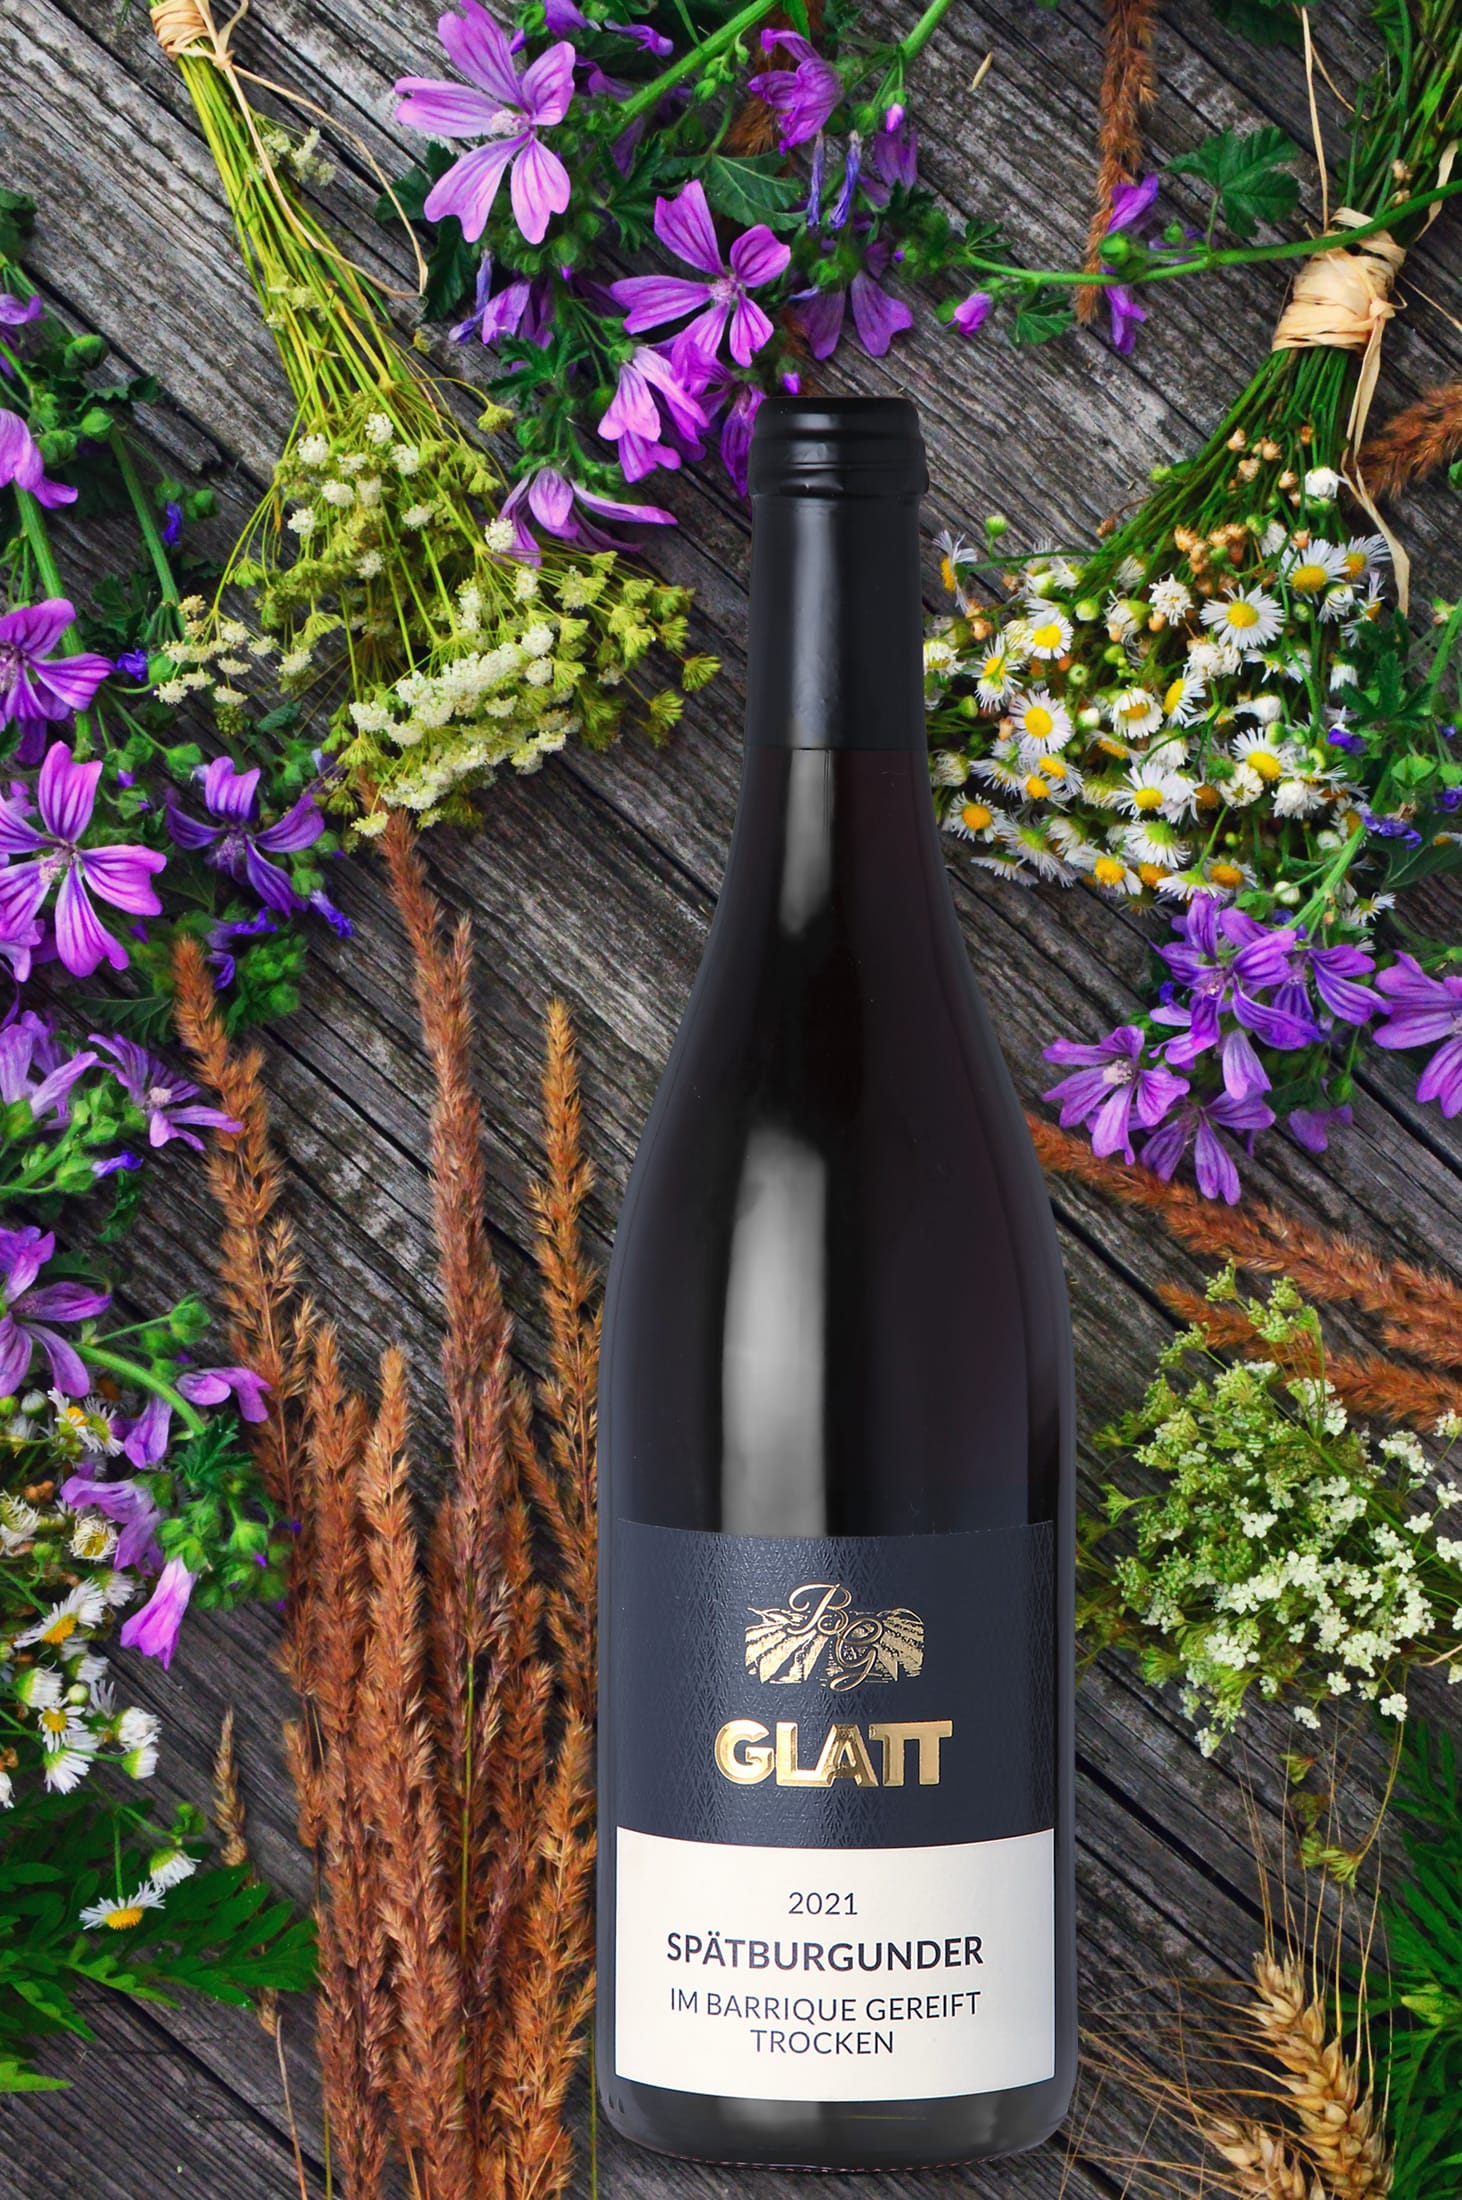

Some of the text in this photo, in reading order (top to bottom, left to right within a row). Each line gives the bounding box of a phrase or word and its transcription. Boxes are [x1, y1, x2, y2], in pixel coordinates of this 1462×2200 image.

[714, 1719, 953, 1787] GLATT
[788, 1891, 858, 1916] 2021
[667, 1930, 984, 1972] SPÄTBURGUNDER
[670, 1987, 982, 2026] IM BARRIQUE GEREIFT
[750, 2029, 893, 2055] TROCKEN
